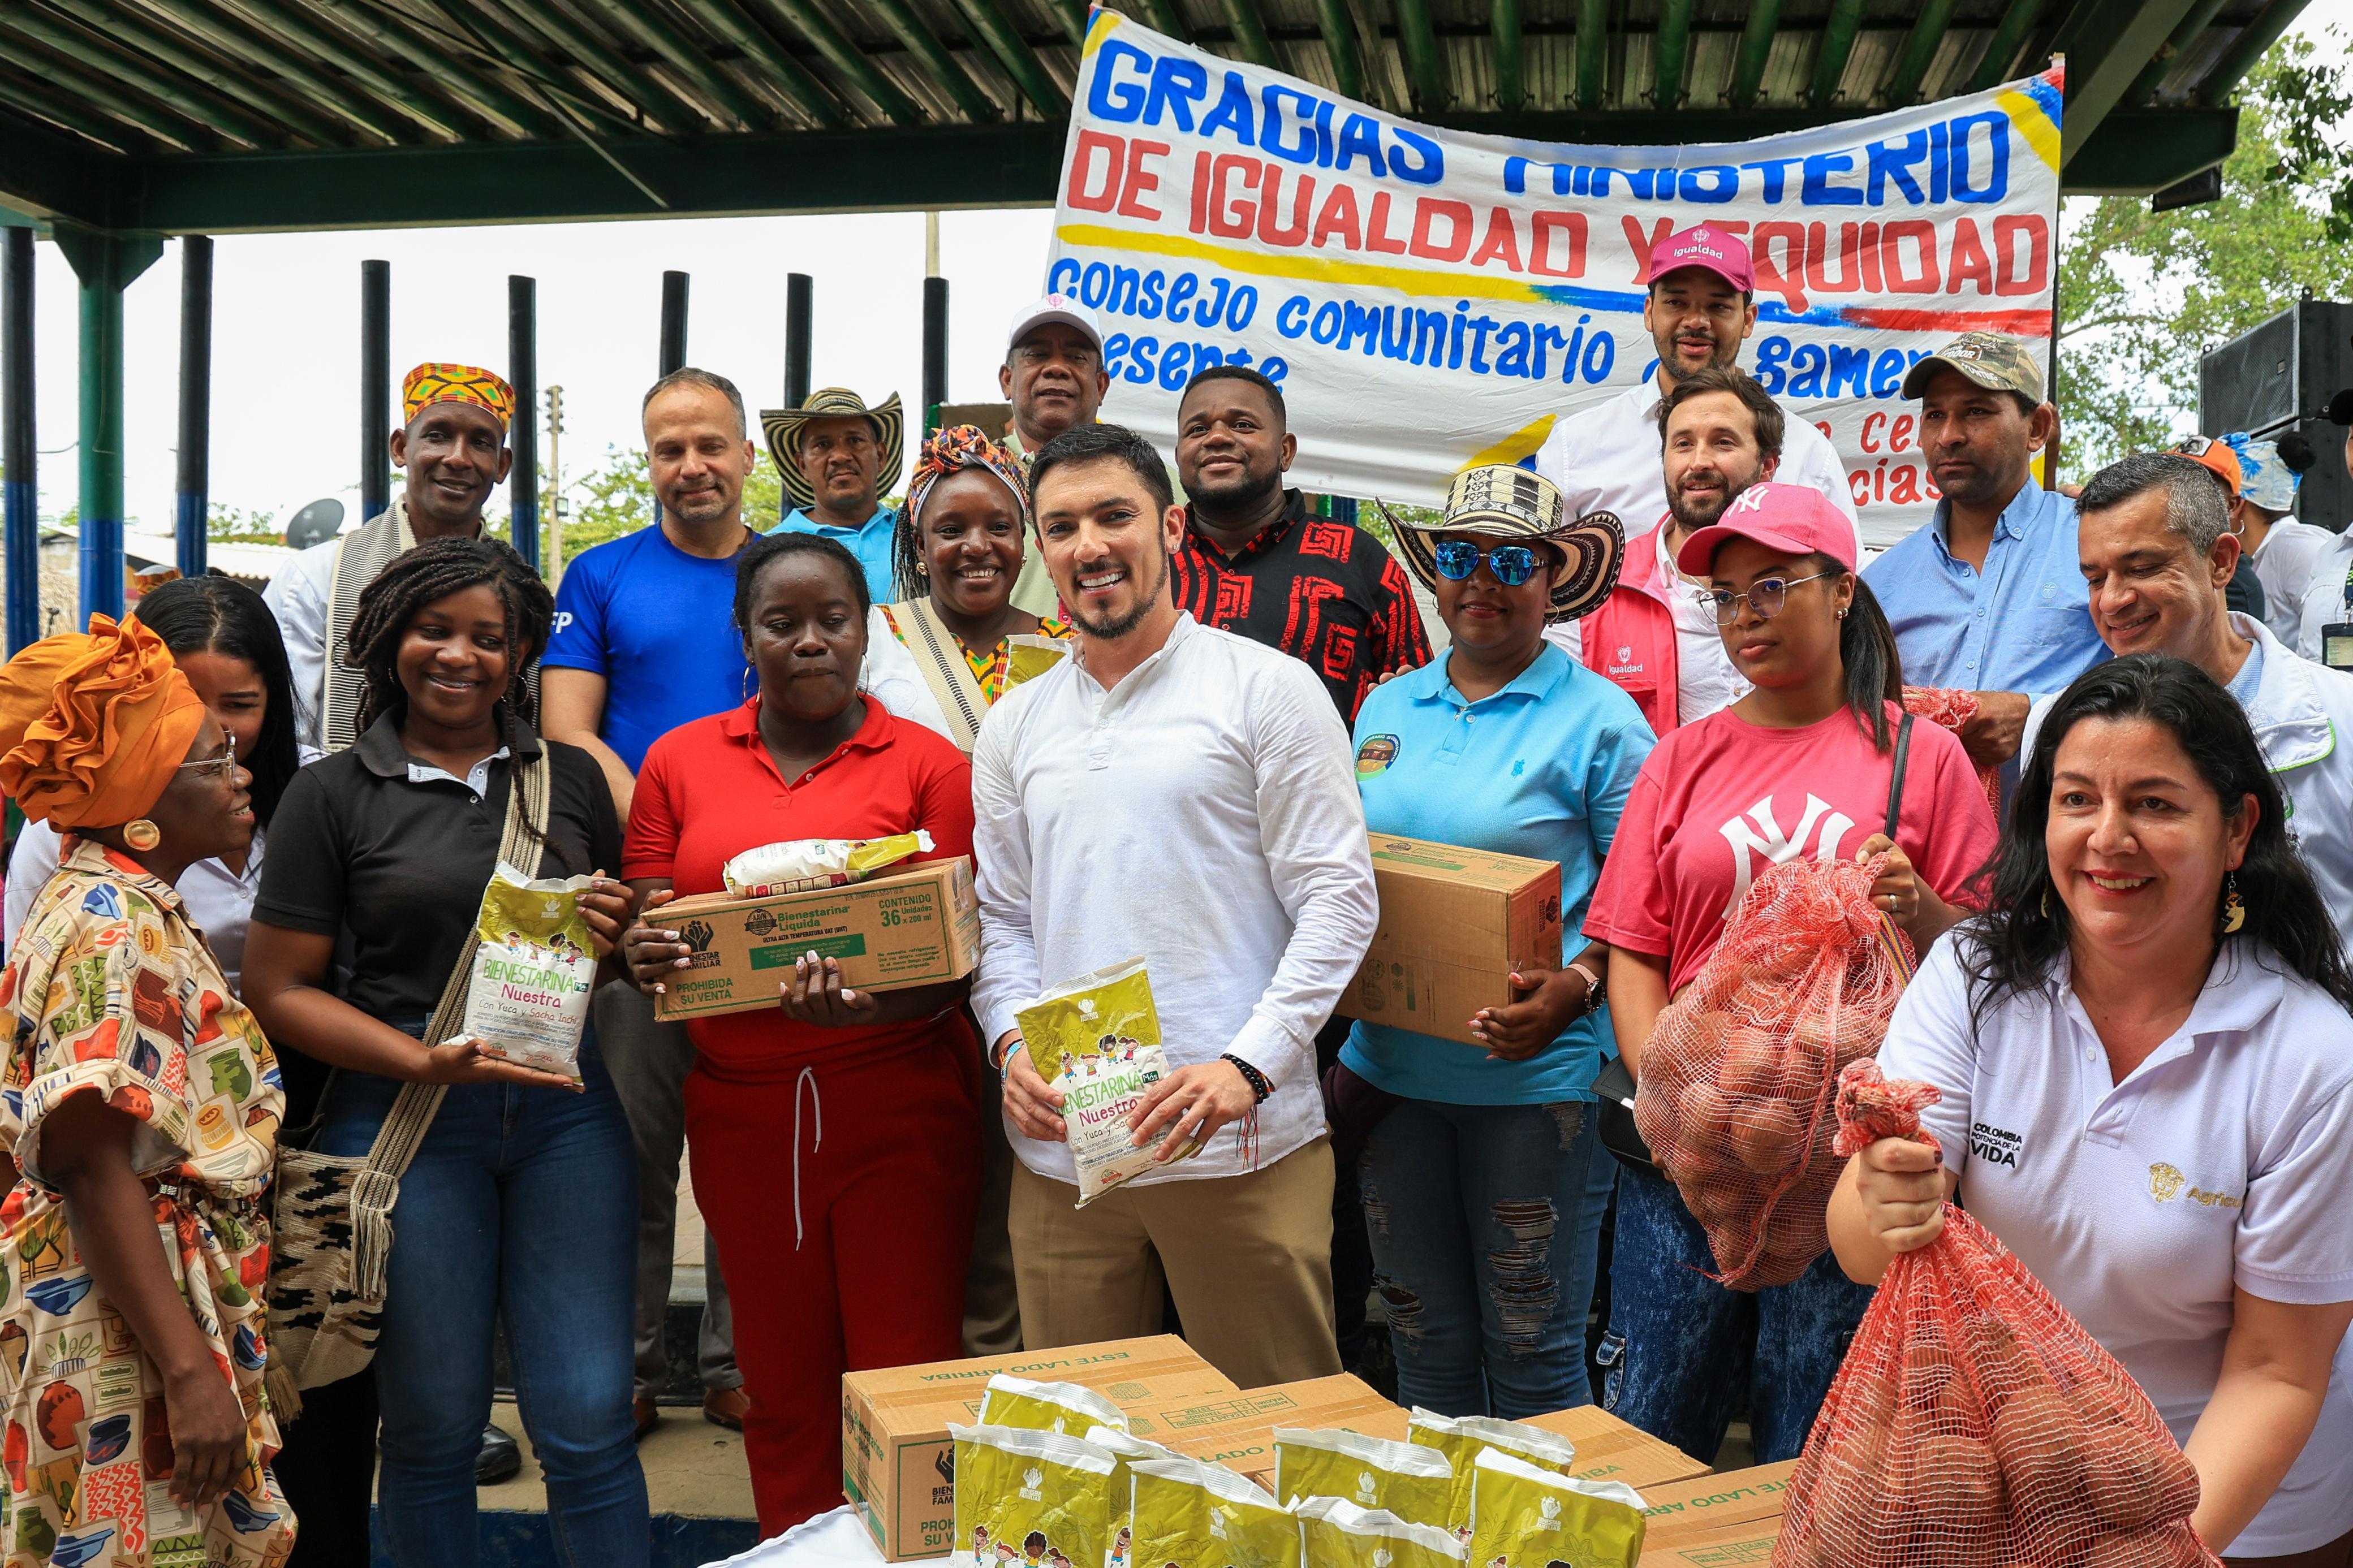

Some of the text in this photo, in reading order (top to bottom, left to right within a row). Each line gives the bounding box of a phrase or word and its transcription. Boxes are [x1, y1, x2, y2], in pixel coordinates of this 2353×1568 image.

[1087, 38, 2011, 206] GRACIAS MINISTERIO
[1066, 129, 1170, 222] DE
[1188, 150, 1588, 278] IGUALDAD
[1621, 214, 1674, 285] Y
[1674, 244, 1723, 260] Igualdad
[1277, 296, 1615, 384] comunitario
[1609, 663, 1643, 675] Igualdad
[879, 894, 931, 909] CONTENIDO
[881, 909, 901, 927] 36
[902, 905, 933, 914] Unidades
[790, 930, 824, 939] TEMPERATURA
[689, 951, 719, 961] ENESTAR
[482, 958, 574, 994] BIENESTARINA
[676, 978, 734, 993] PROHIBIDA
[501, 984, 561, 1008] Nuestra
[681, 990, 732, 1004] SU VENTA
[479, 999, 494, 1010] Con
[498, 1003, 517, 1014] Yuca
[529, 1008, 554, 1020] Sacha
[558, 1013, 577, 1024] Inchi
[1143, 1072, 1158, 1082] Más
[1058, 1070, 1144, 1116] ENESTARINA
[1079, 1098, 1137, 1127] Nuestra
[1071, 1137, 1083, 1146] Con
[1084, 1129, 1103, 1140] Yuca
[1104, 1125, 1111, 1136] y
[1971, 1131, 2001, 1146] POTENCIA
[1974, 1123, 2022, 1144] COLOMBIA
[1971, 1139, 2015, 1168] VIDA
[2186, 1186, 2244, 1208] Agricu
[919, 1352, 1130, 1381] ESTE LADO ARRIBA
[1199, 1446, 1264, 1462] LADO
[932, 1486, 954, 1496] BIEN
[1691, 1488, 1757, 1507] LADO
[932, 1497, 954, 1506] FAM
[920, 1518, 955, 1533] PROH
[924, 1535, 941, 1547] SU
